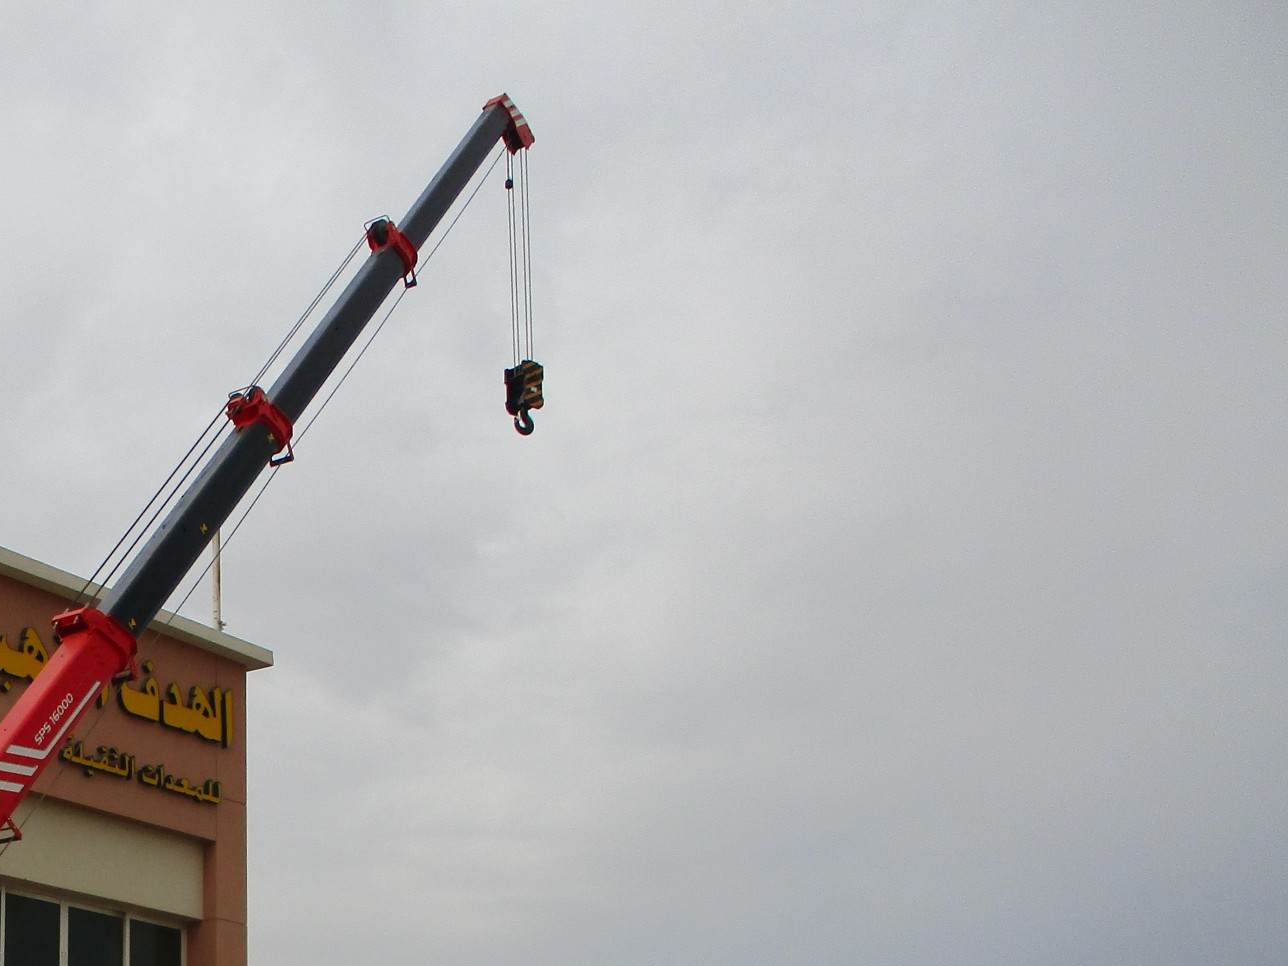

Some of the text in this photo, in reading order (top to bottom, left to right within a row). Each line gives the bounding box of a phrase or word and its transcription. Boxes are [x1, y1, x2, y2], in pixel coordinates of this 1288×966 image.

[34, 692, 74, 746] SPS 16000
[117, 660, 233, 749] الهدف
[60, 735, 223, 805] للمعدات الثقيلة
